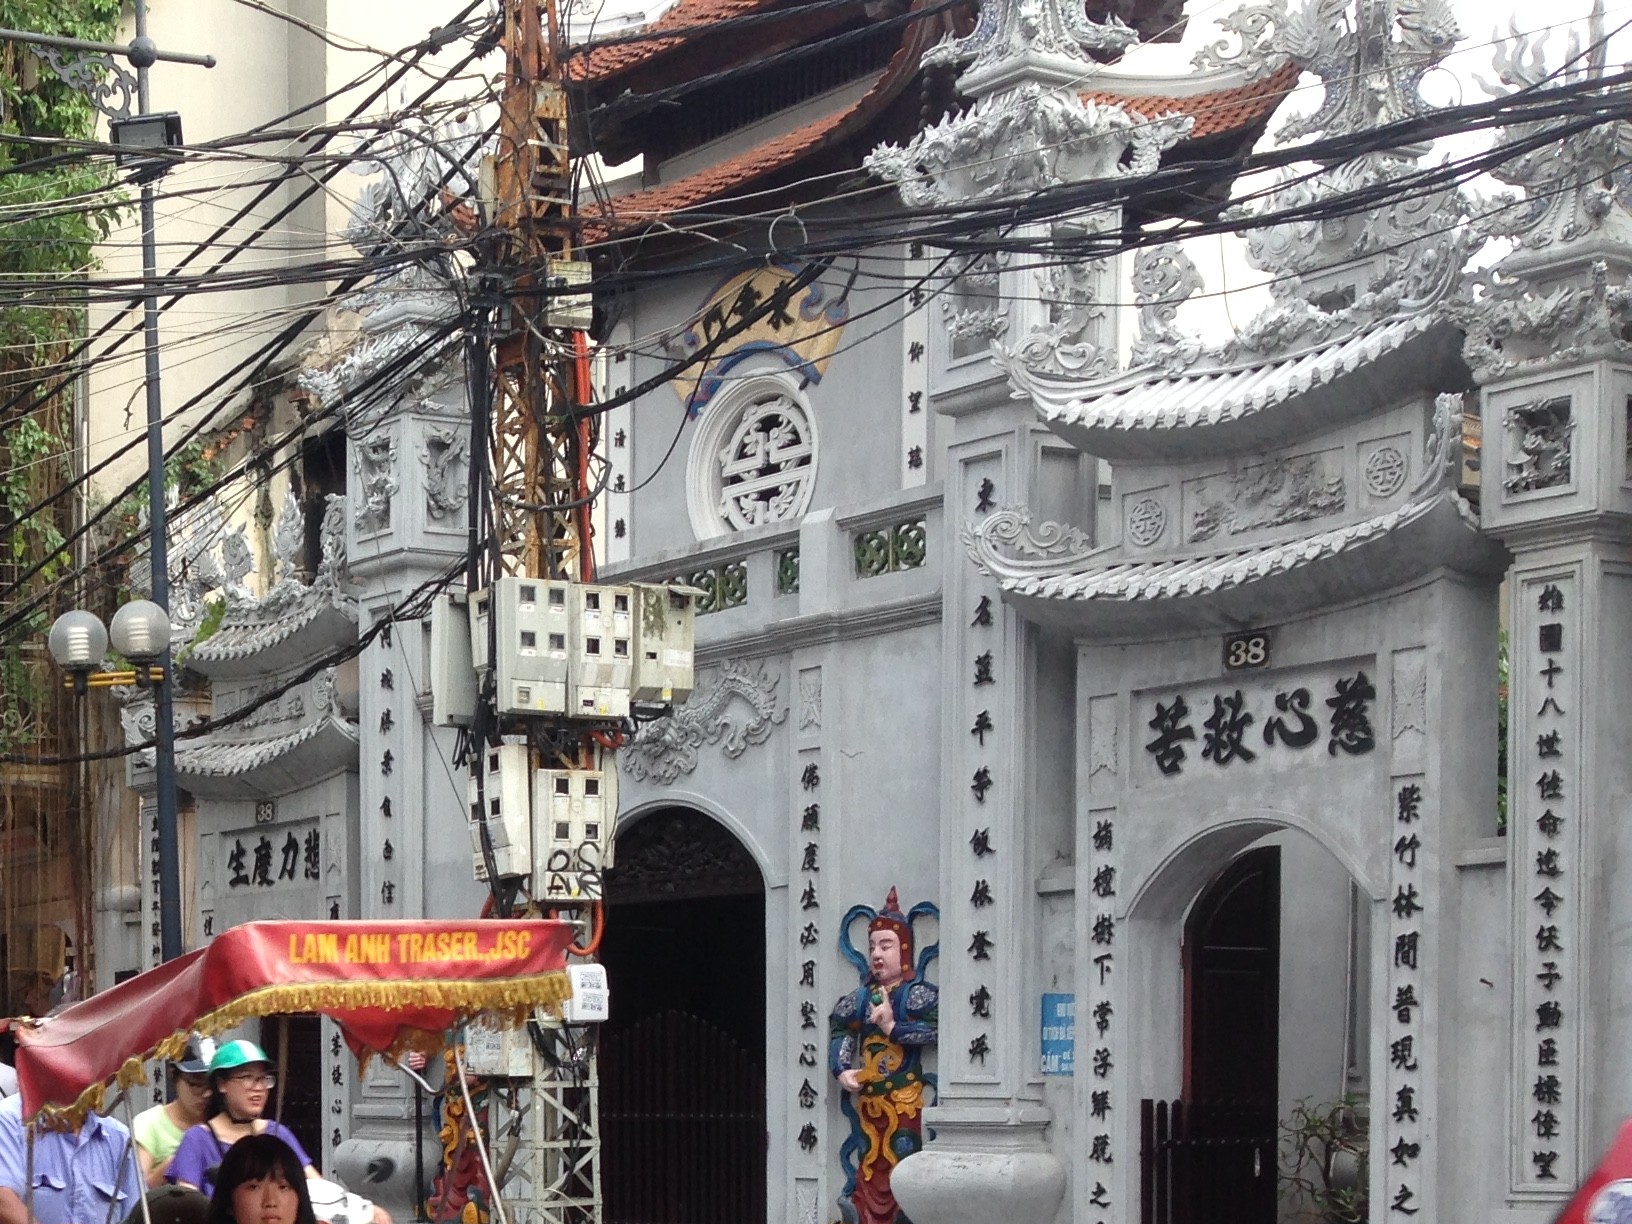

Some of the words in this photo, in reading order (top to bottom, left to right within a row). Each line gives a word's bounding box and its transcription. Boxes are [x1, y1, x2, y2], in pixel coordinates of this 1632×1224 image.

[1228, 637, 1267, 667] 38
[257, 803, 273, 822] 38
[289, 932, 340, 964] LAM
[344, 932, 391, 964] ANH
